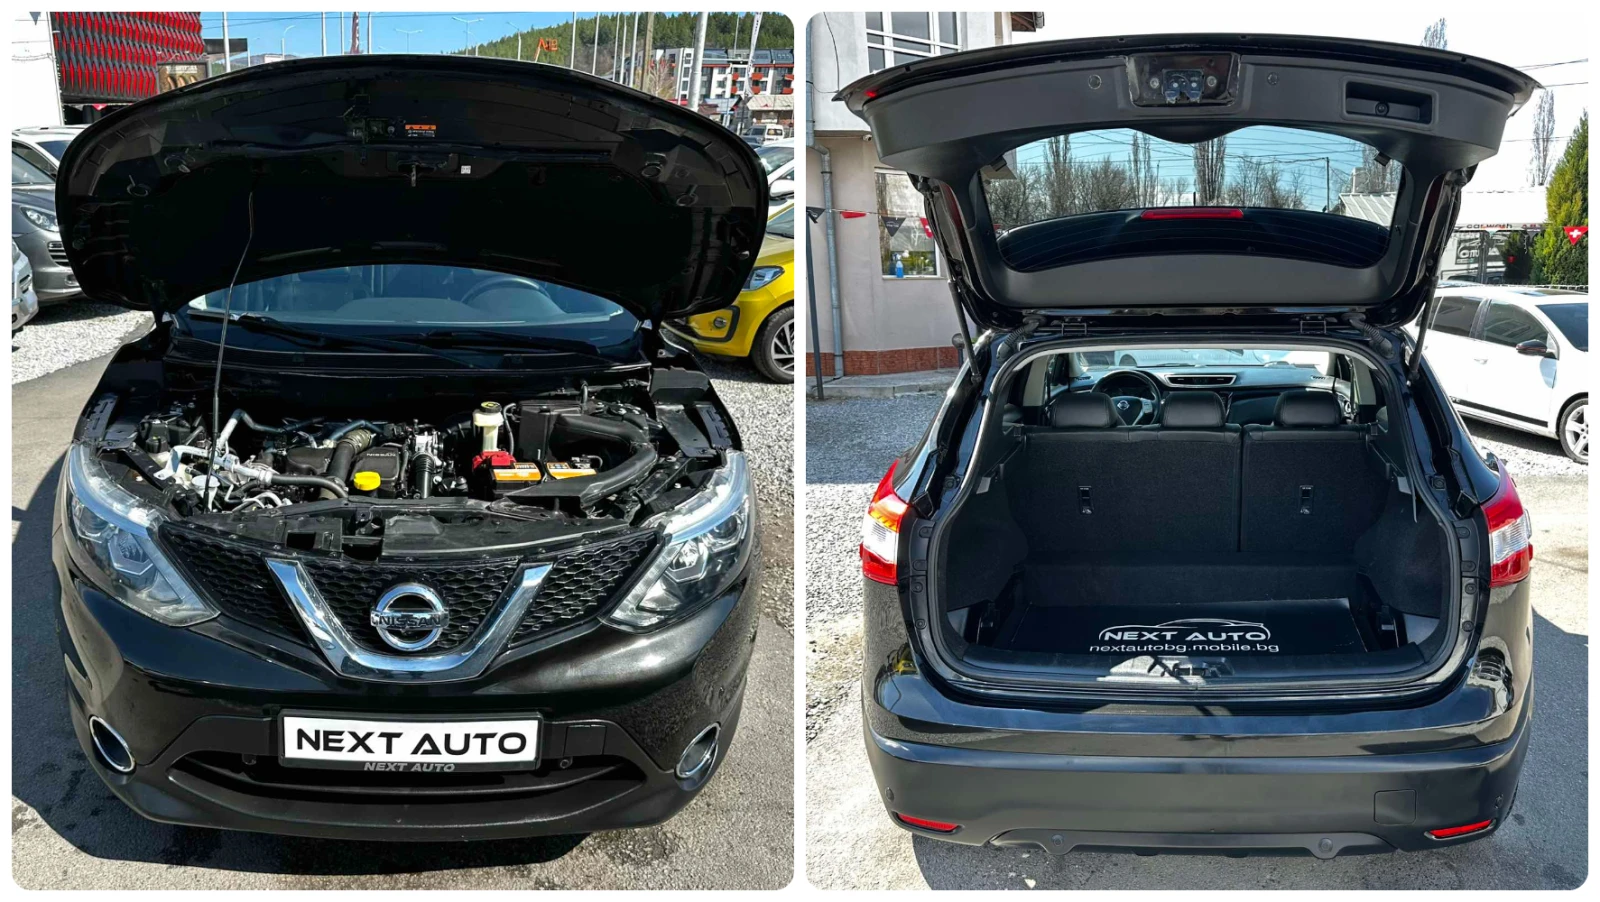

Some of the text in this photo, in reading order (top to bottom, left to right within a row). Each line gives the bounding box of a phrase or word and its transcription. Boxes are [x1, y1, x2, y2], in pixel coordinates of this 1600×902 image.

[378, 616, 442, 627] NISSAN
[1103, 631, 1267, 641] NEXT AUTO
[1089, 643, 1280, 653] nextautobg.mobile.bg
[296, 728, 527, 756] NEXT AUTO
[363, 762, 456, 772] NEXT AUTO
